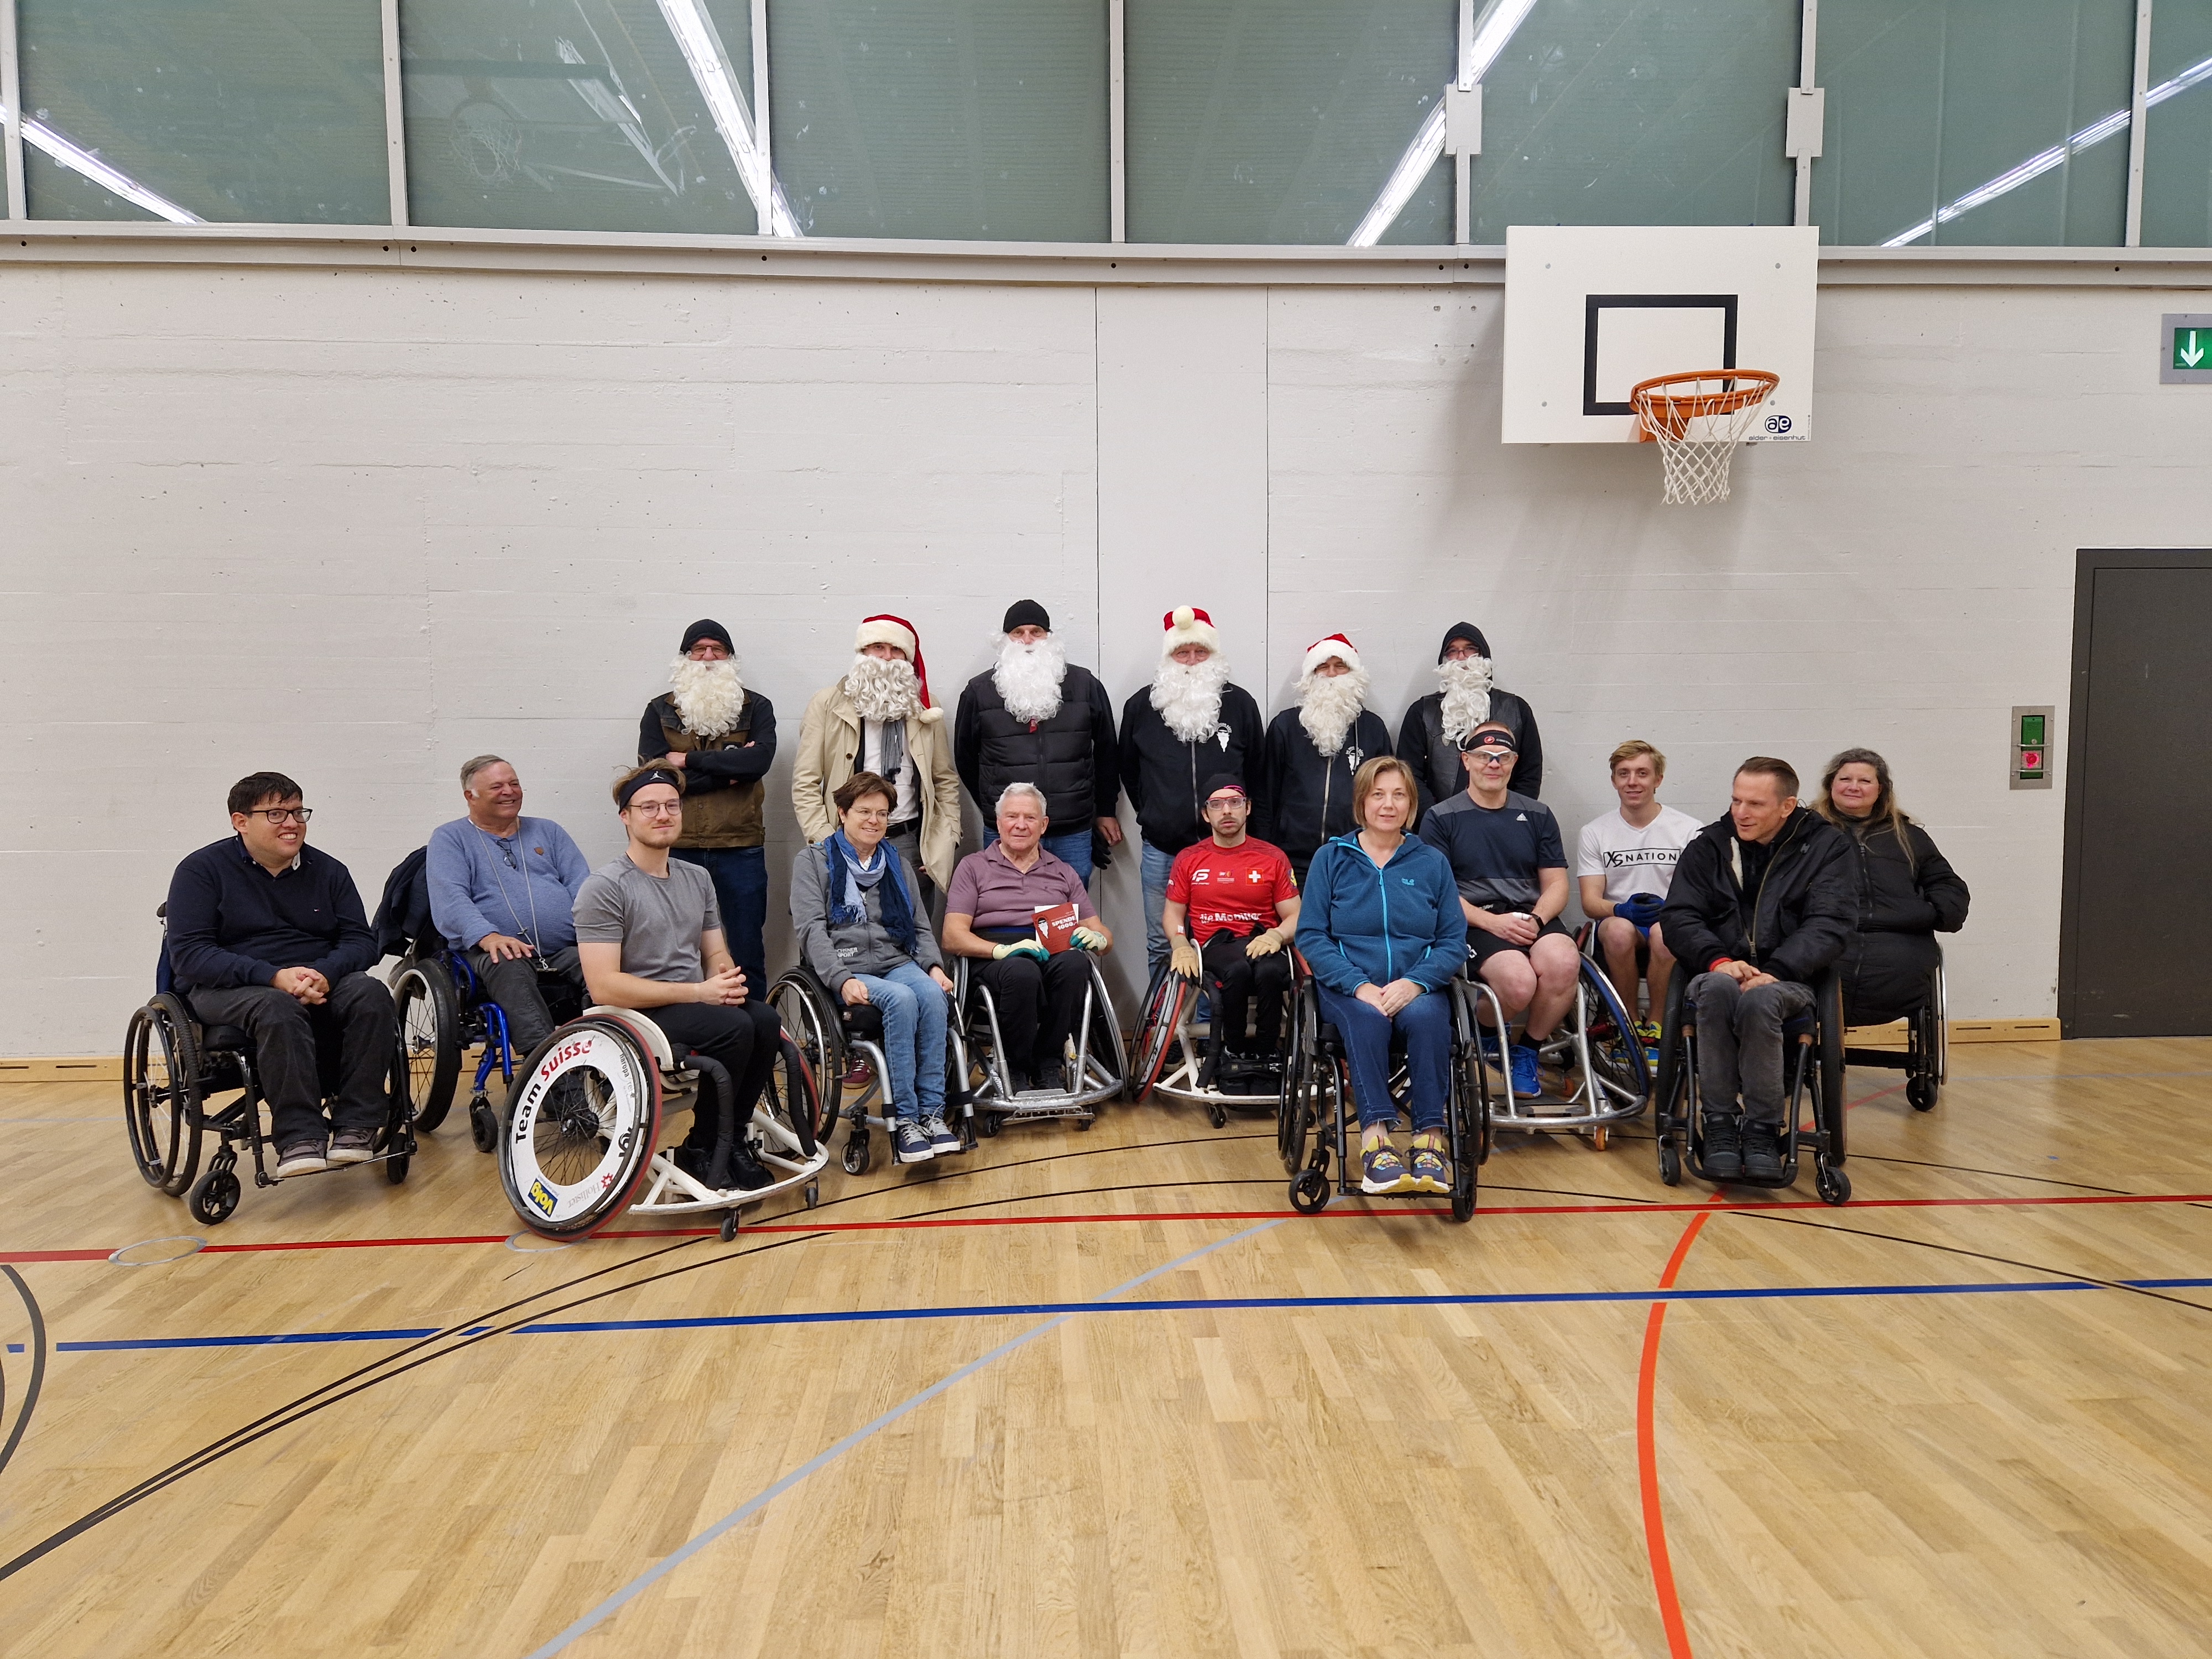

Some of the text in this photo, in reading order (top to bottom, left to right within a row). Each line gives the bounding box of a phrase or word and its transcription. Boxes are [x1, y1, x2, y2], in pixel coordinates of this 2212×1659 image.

[1051, 915, 1076, 927] SPENDE
[515, 1083, 541, 1144] Team
[530, 1181, 554, 1215] Volg
[567, 1182, 601, 1208] Hollister
